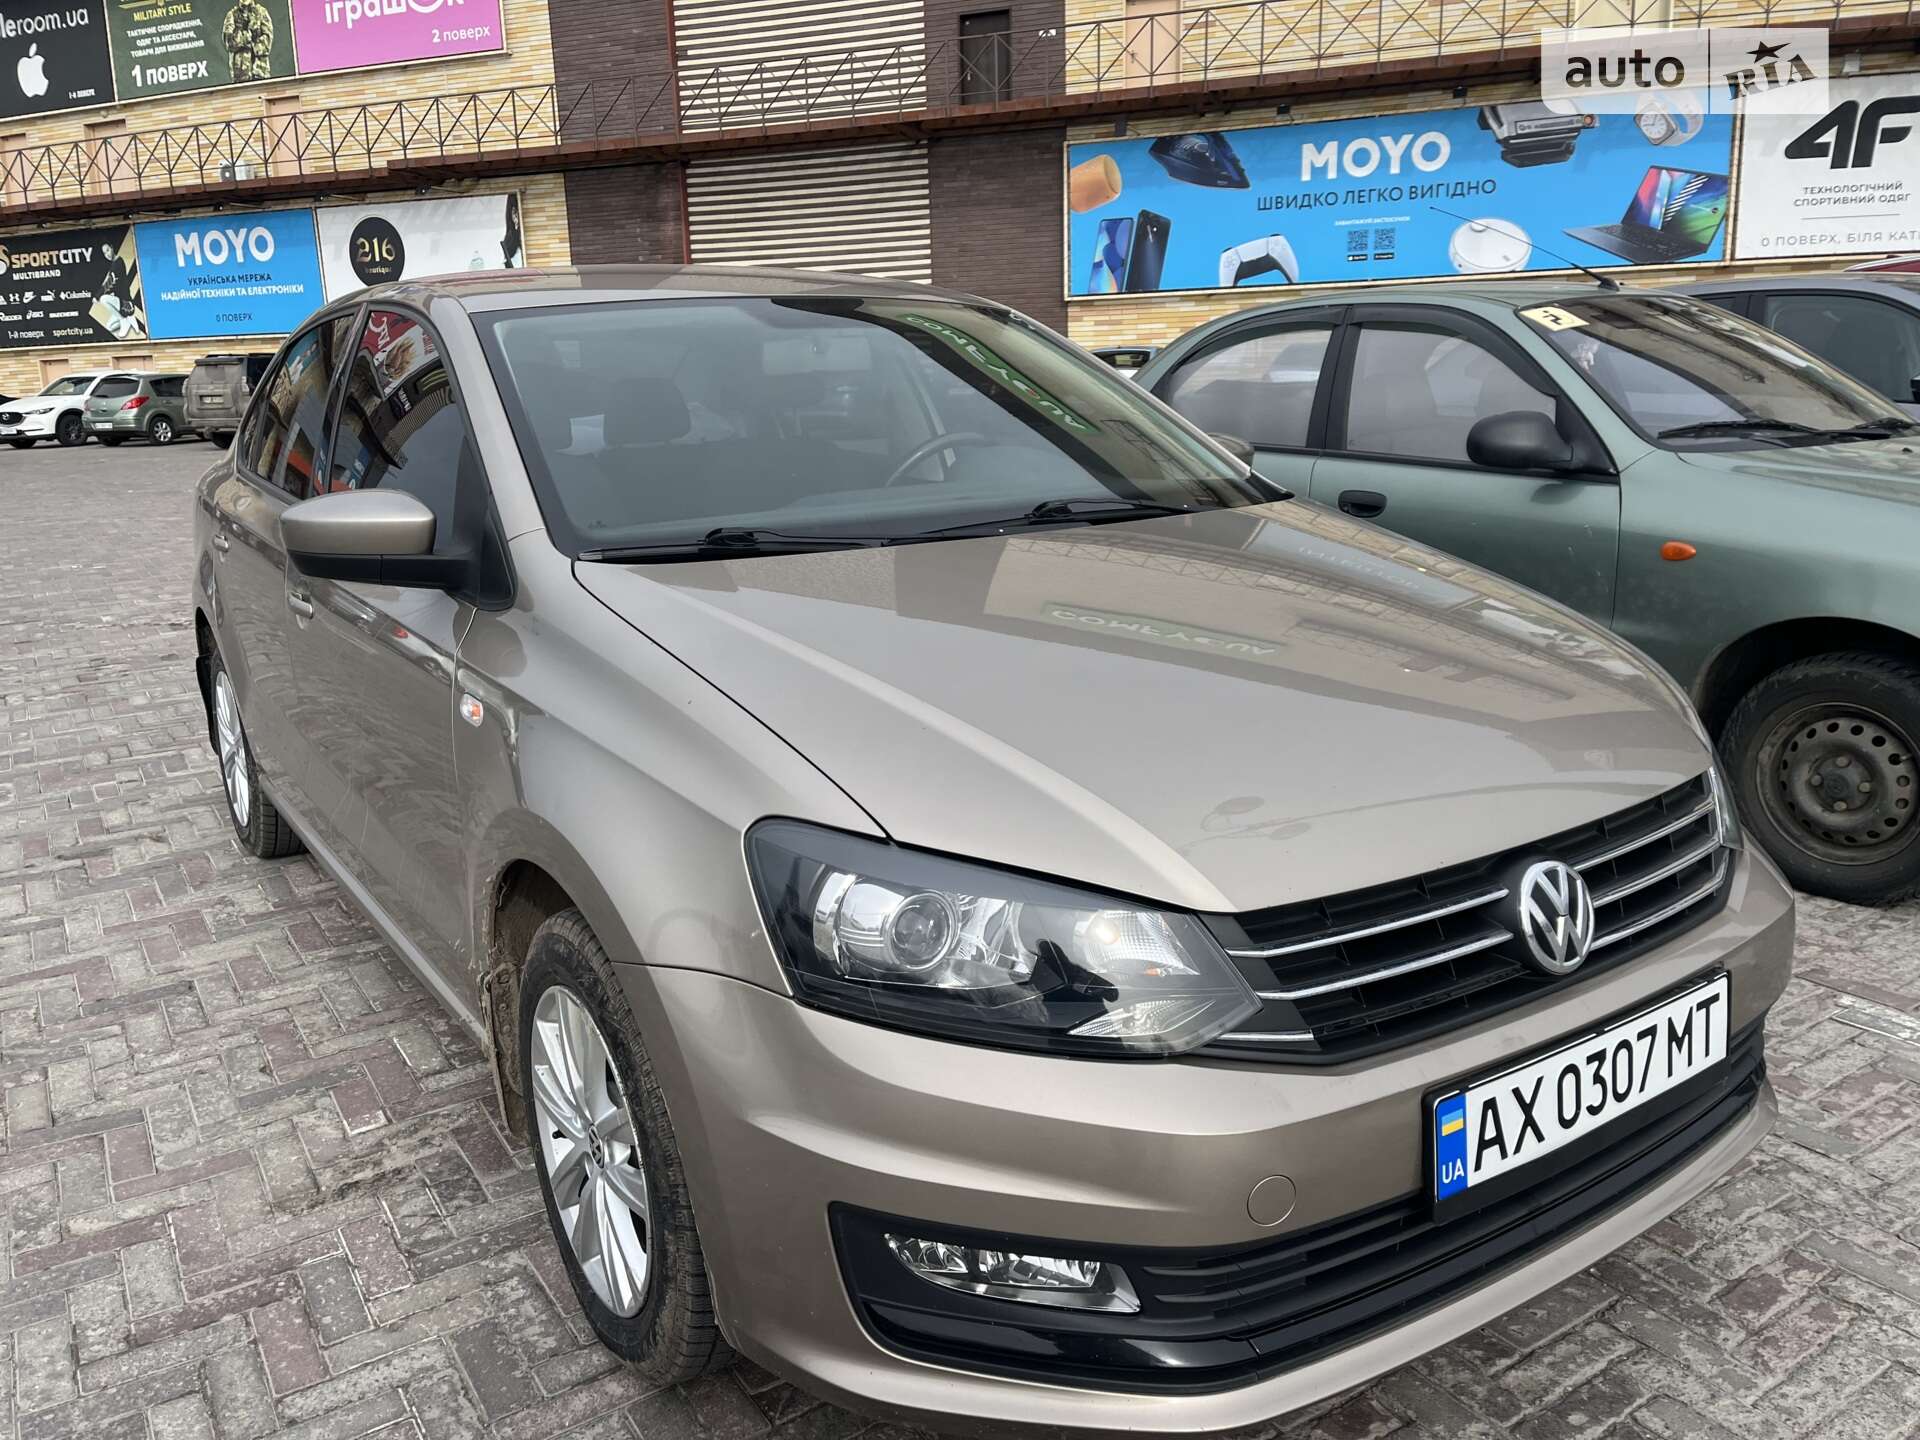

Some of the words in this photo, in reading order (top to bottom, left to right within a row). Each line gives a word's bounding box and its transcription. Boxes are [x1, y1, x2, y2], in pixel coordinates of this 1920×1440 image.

[133, 7, 167, 21] MILITARY
[168, 3, 192, 16] STYLE
[432, 29, 440, 43] 2
[443, 25, 490, 42] поверх
[131, 64, 142, 87] 1
[1784, 95, 1920, 170] 4F
[1300, 131, 1451, 182] MOYO
[1257, 191, 1338, 211] ШВИДКО
[1343, 186, 1404, 205] ЛЕГКО
[1408, 179, 1497, 200] ВИГІДНО
[1803, 181, 1903, 195] ТЕХНОЛОГІЧНИЙ
[1793, 195, 1876, 207] СПОРТИВНИЙ
[1879, 193, 1911, 204] ОДЯГ
[174, 226, 275, 267] MOYO
[1761, 237, 1770, 247] 0
[1847, 231, 1883, 243] БІЛЯ
[1889, 230, 1920, 241] КАТ
[11, 247, 93, 269] SPORTCITY
[355, 236, 396, 262] 216
[12, 269, 61, 281] MULTIBRAND
[187, 274, 237, 286] УКРАЇНСЬКА
[237, 273, 272, 283] МЕРЕЖА
[160, 289, 201, 301] НАДІЙНОЇ
[201, 288, 236, 298] ТЕХНІКИ
[236, 288, 247, 297] ТА
[247, 284, 304, 296] ЕЛЕКТРОНІКИ
[222, 312, 253, 321] ПОВЕРХ
[1556, 1023, 1659, 1130] 0307
[1441, 1158, 1465, 1184] UA
